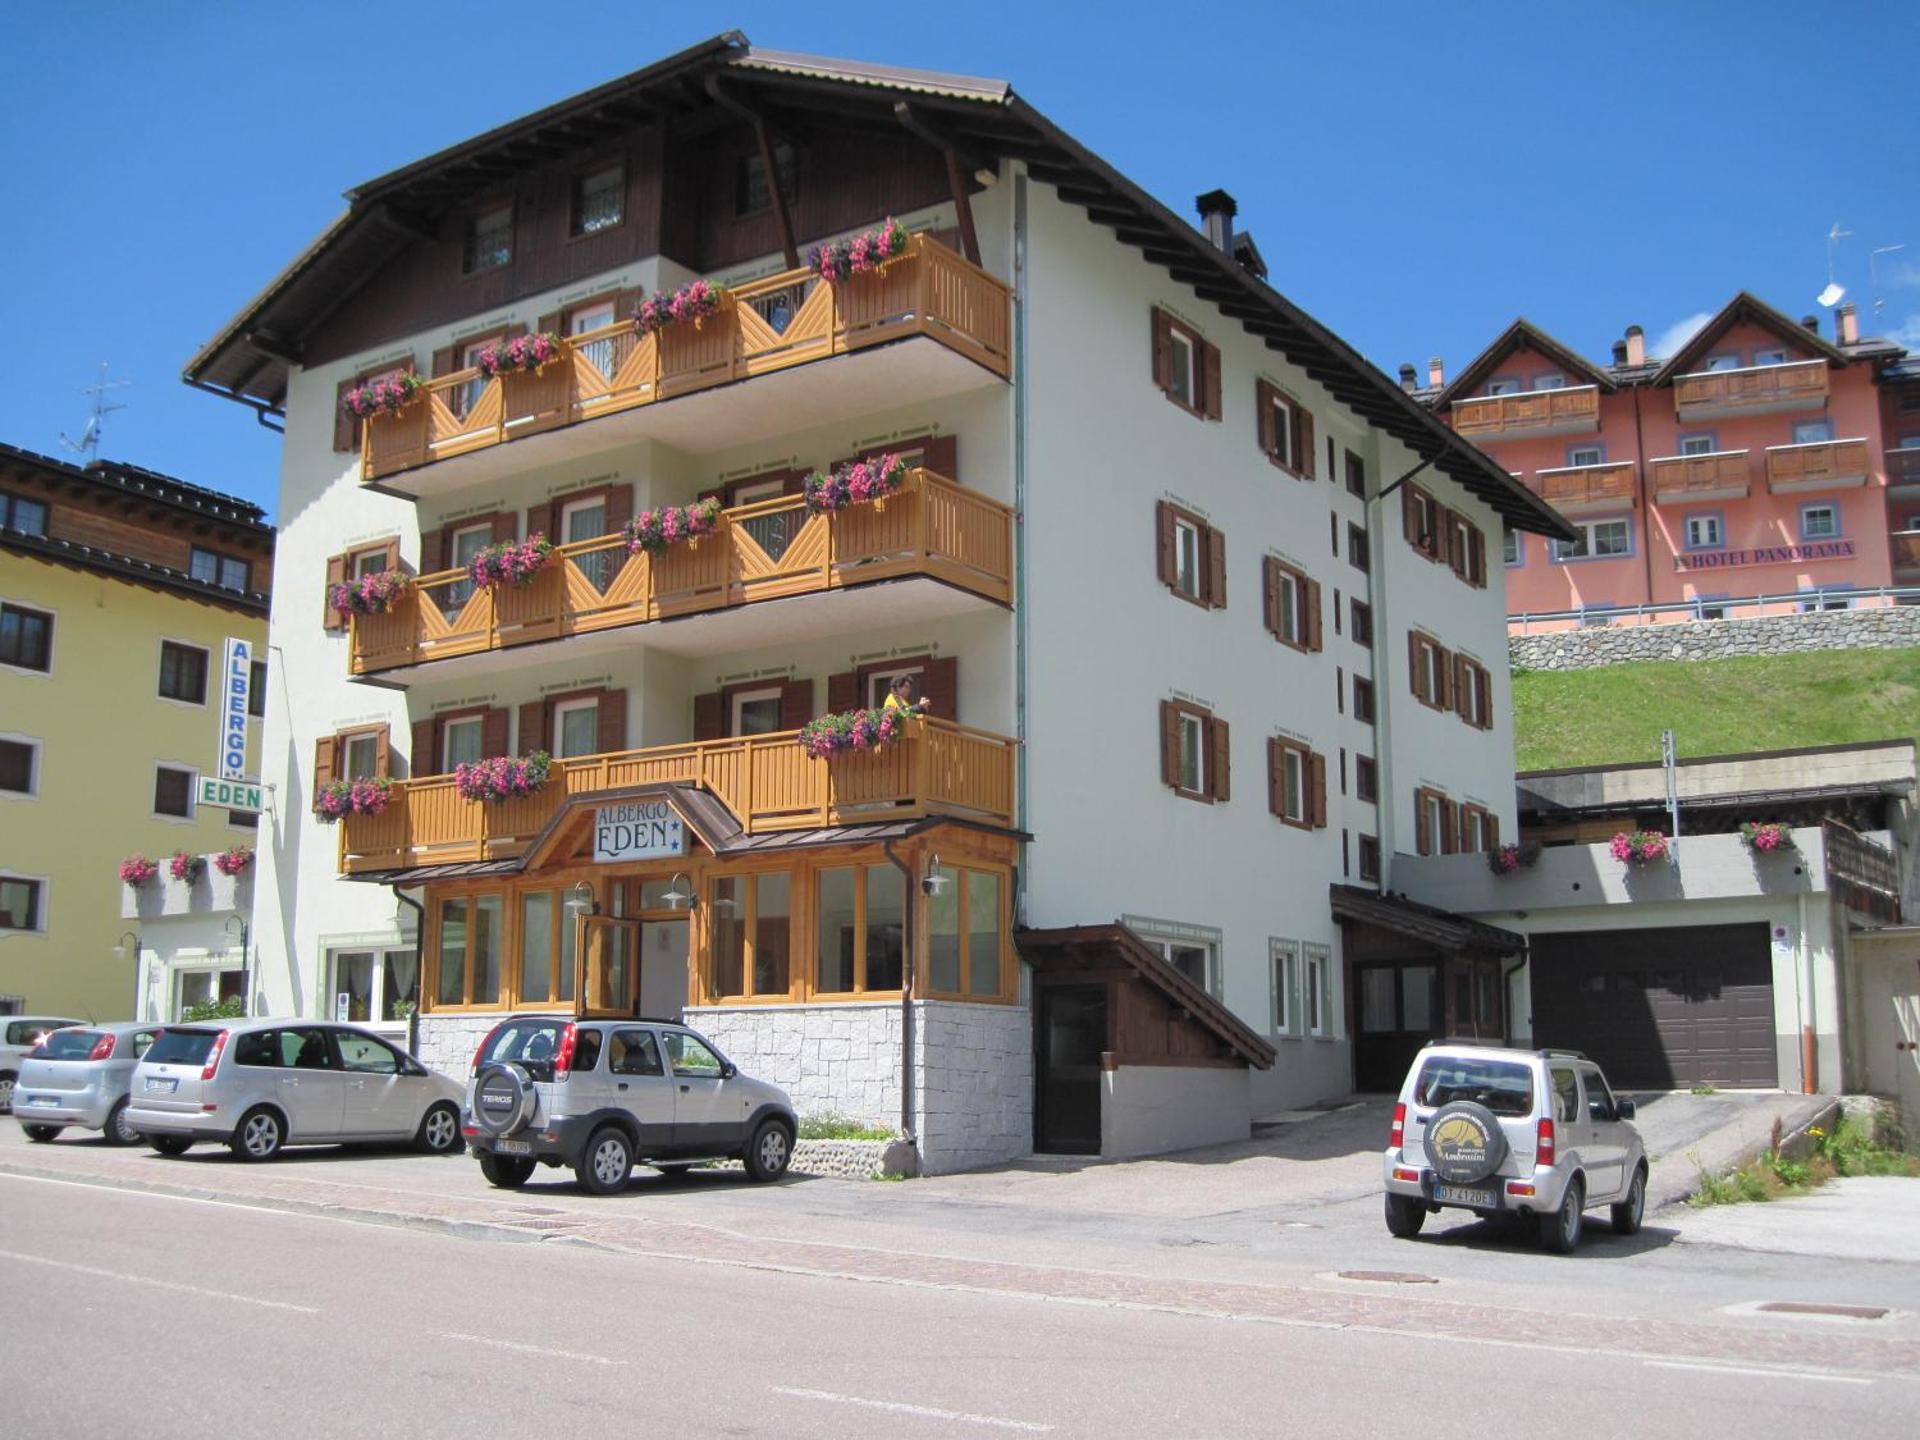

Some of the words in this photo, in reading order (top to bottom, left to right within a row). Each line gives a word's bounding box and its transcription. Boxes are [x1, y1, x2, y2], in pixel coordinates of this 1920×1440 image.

[1692, 550, 1748, 568] HOTEL
[1754, 541, 1856, 563] PANORAMA
[226, 642, 249, 769] ALBERGO
[204, 781, 261, 808] EDEN
[598, 801, 669, 825] ALBERGO
[597, 820, 667, 857] EDEN
[482, 1095, 513, 1104] TERIOS
